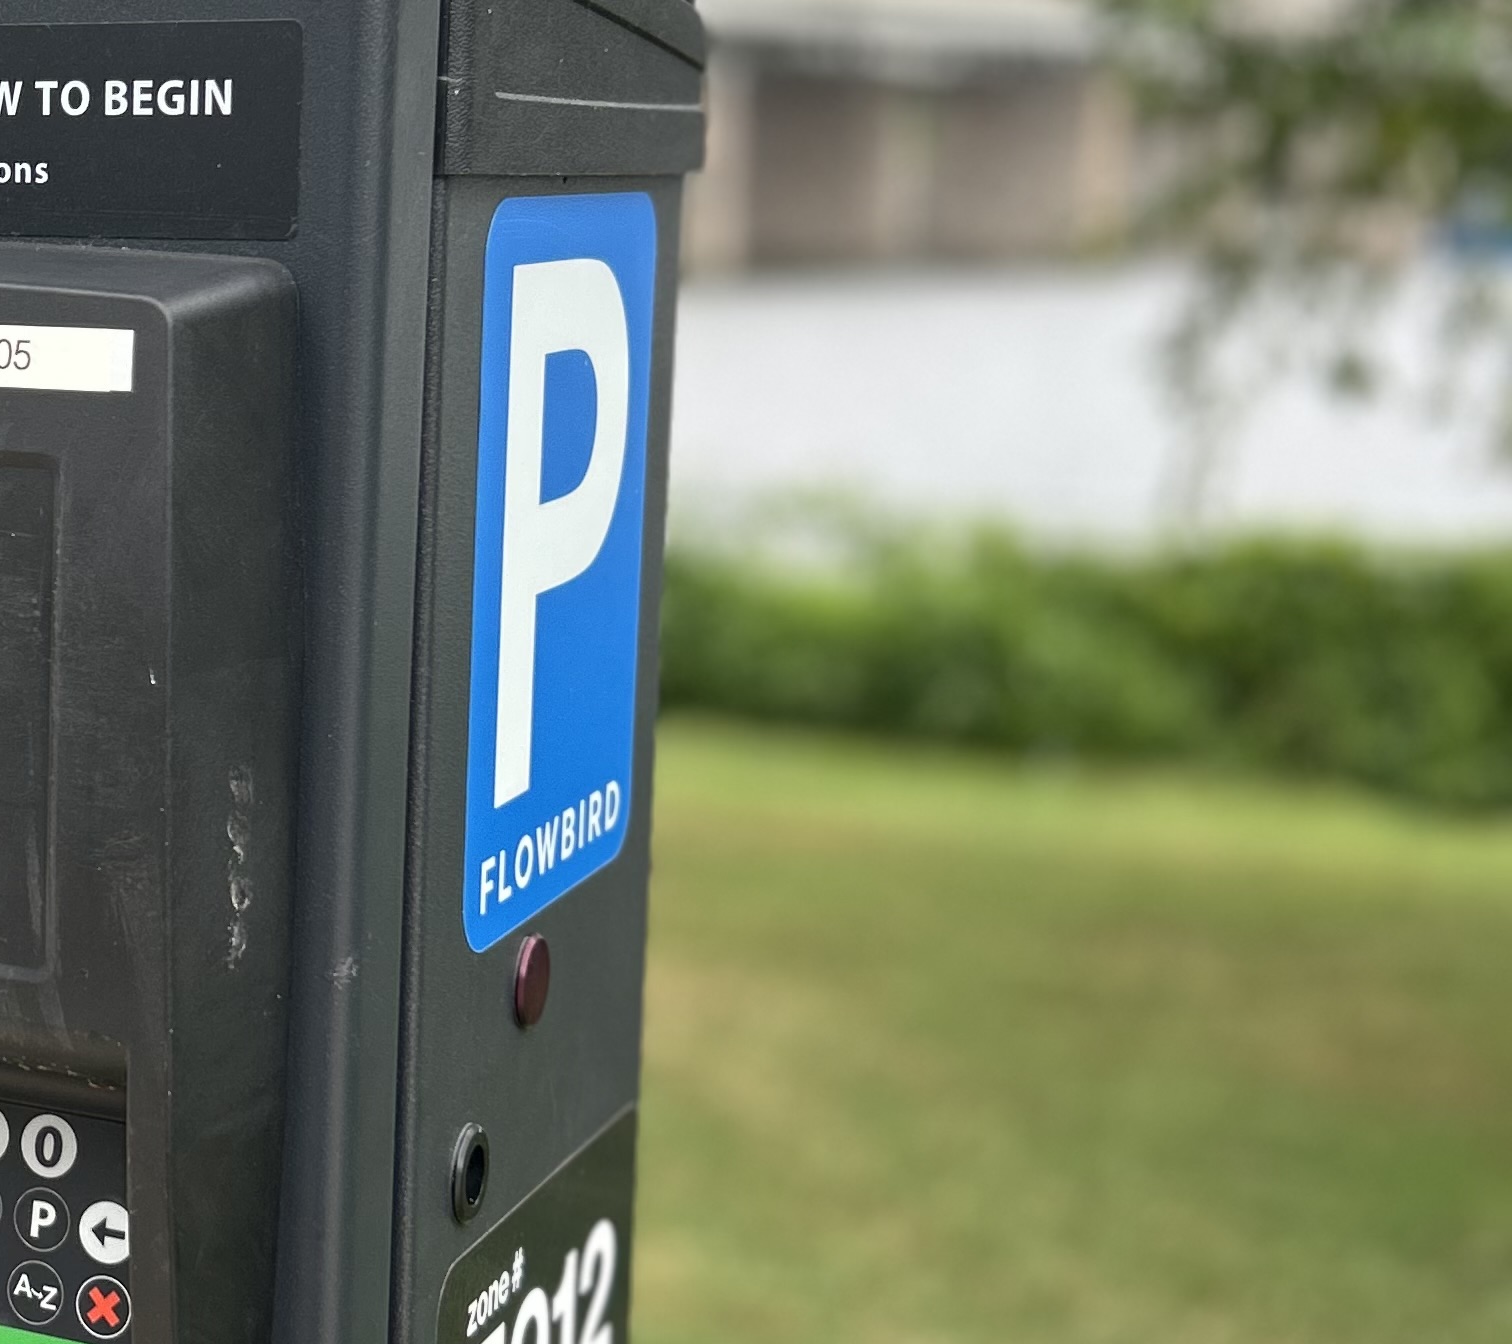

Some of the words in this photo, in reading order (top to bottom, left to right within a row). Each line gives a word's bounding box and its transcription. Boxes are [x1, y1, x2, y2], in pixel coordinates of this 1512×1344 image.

[35, 81, 89, 115] TO
[105, 80, 232, 115] BEGIN
[493, 258, 630, 809] P
[479, 780, 620, 916] FLOWBIRD
[35, 1125, 63, 1169] 0
[30, 1200, 57, 1238] P
[466, 1270, 510, 1338] zone
